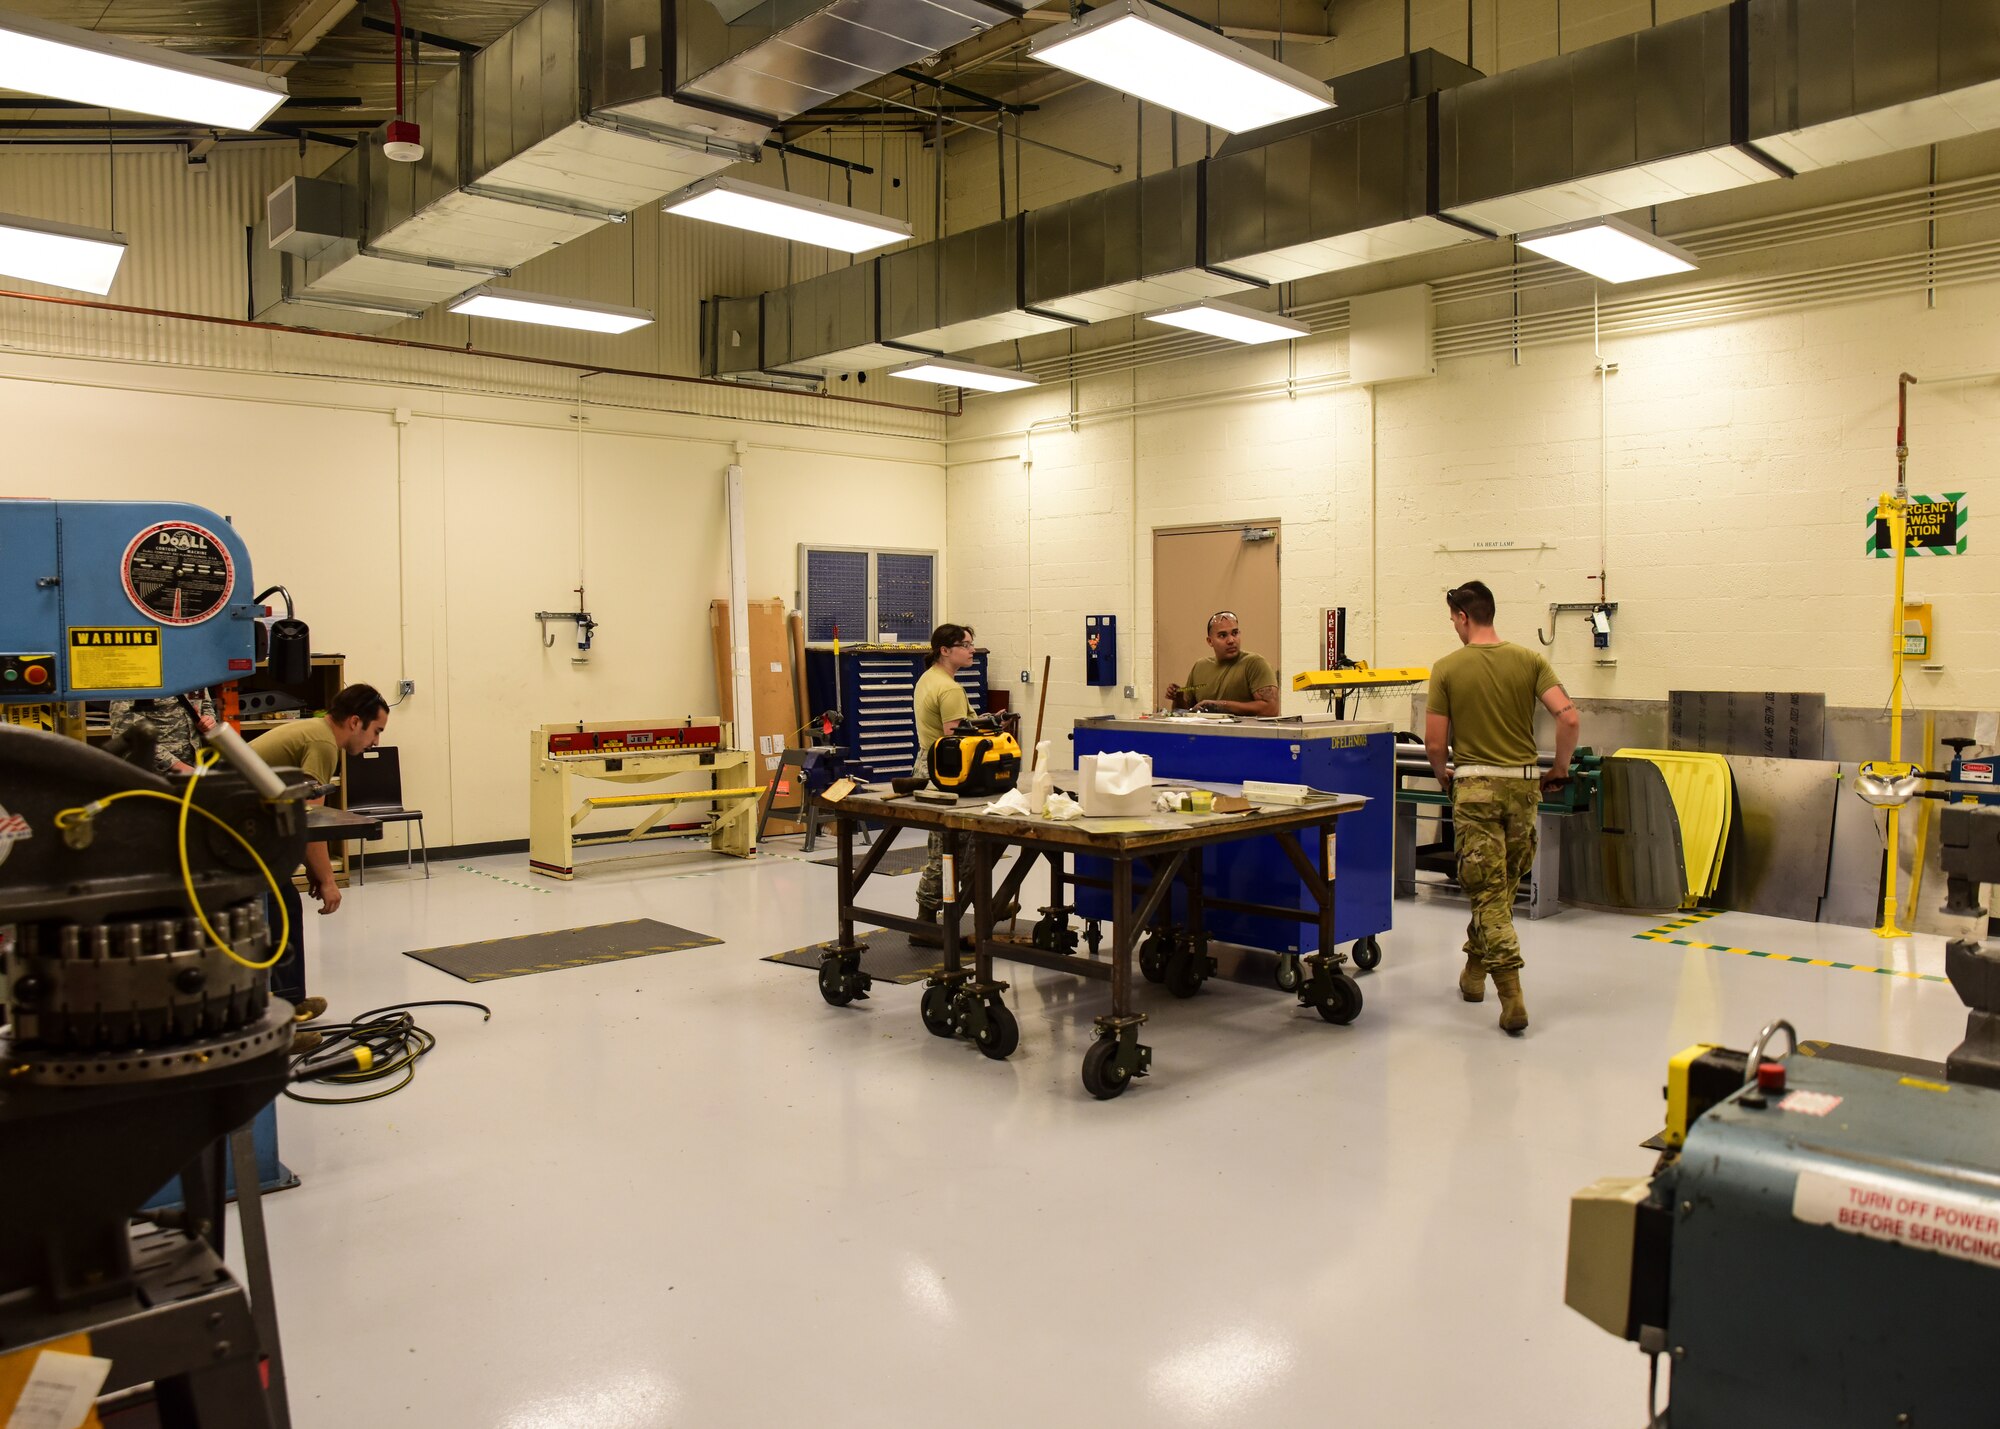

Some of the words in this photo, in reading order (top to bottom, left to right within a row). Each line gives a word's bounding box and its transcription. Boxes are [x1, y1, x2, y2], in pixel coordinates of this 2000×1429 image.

[1906, 502, 1956, 515] RGENCY
[1906, 513, 1946, 526] EWASH
[1905, 525, 1940, 537] ATION
[77, 632, 153, 644] WARNING
[1849, 1186, 1892, 1211] TURN
[1896, 1197, 1929, 1218] OFF
[1934, 1205, 1999, 1235] POWER
[1838, 1206, 1905, 1237] BEFORE
[1909, 1222, 2000, 1261] SERVICING
